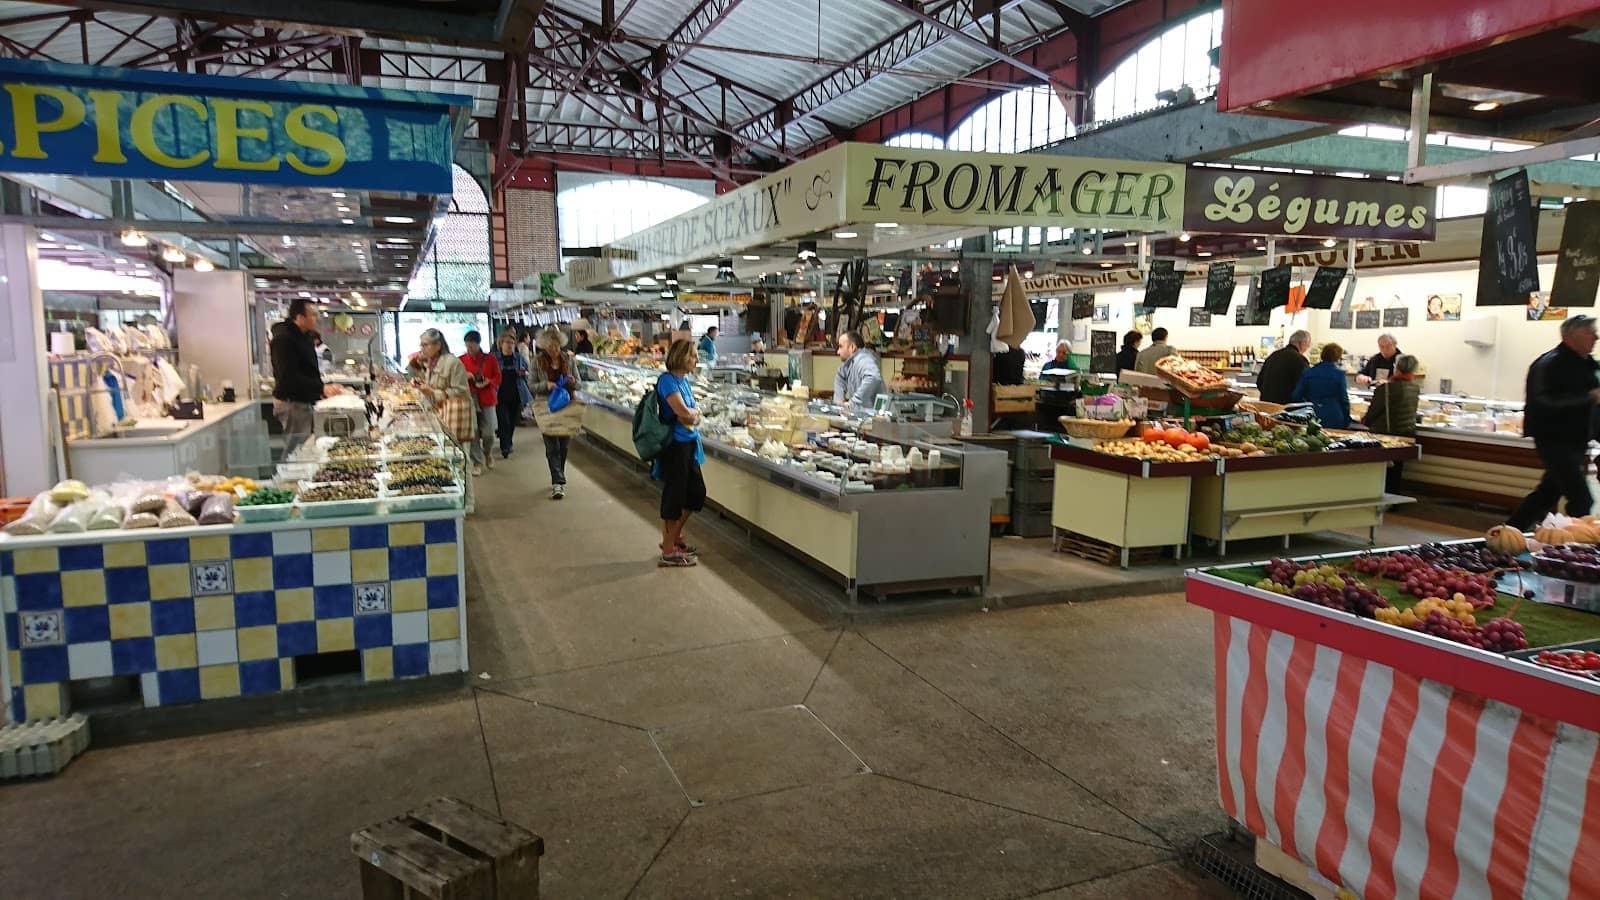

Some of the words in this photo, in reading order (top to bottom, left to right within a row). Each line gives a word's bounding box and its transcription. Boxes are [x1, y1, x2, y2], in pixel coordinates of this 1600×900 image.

[0, 82, 346, 176] PICES
[861, 157, 1176, 222] FROMAGER
[1203, 175, 1428, 234] Légumes
[681, 214, 700, 252] DE
